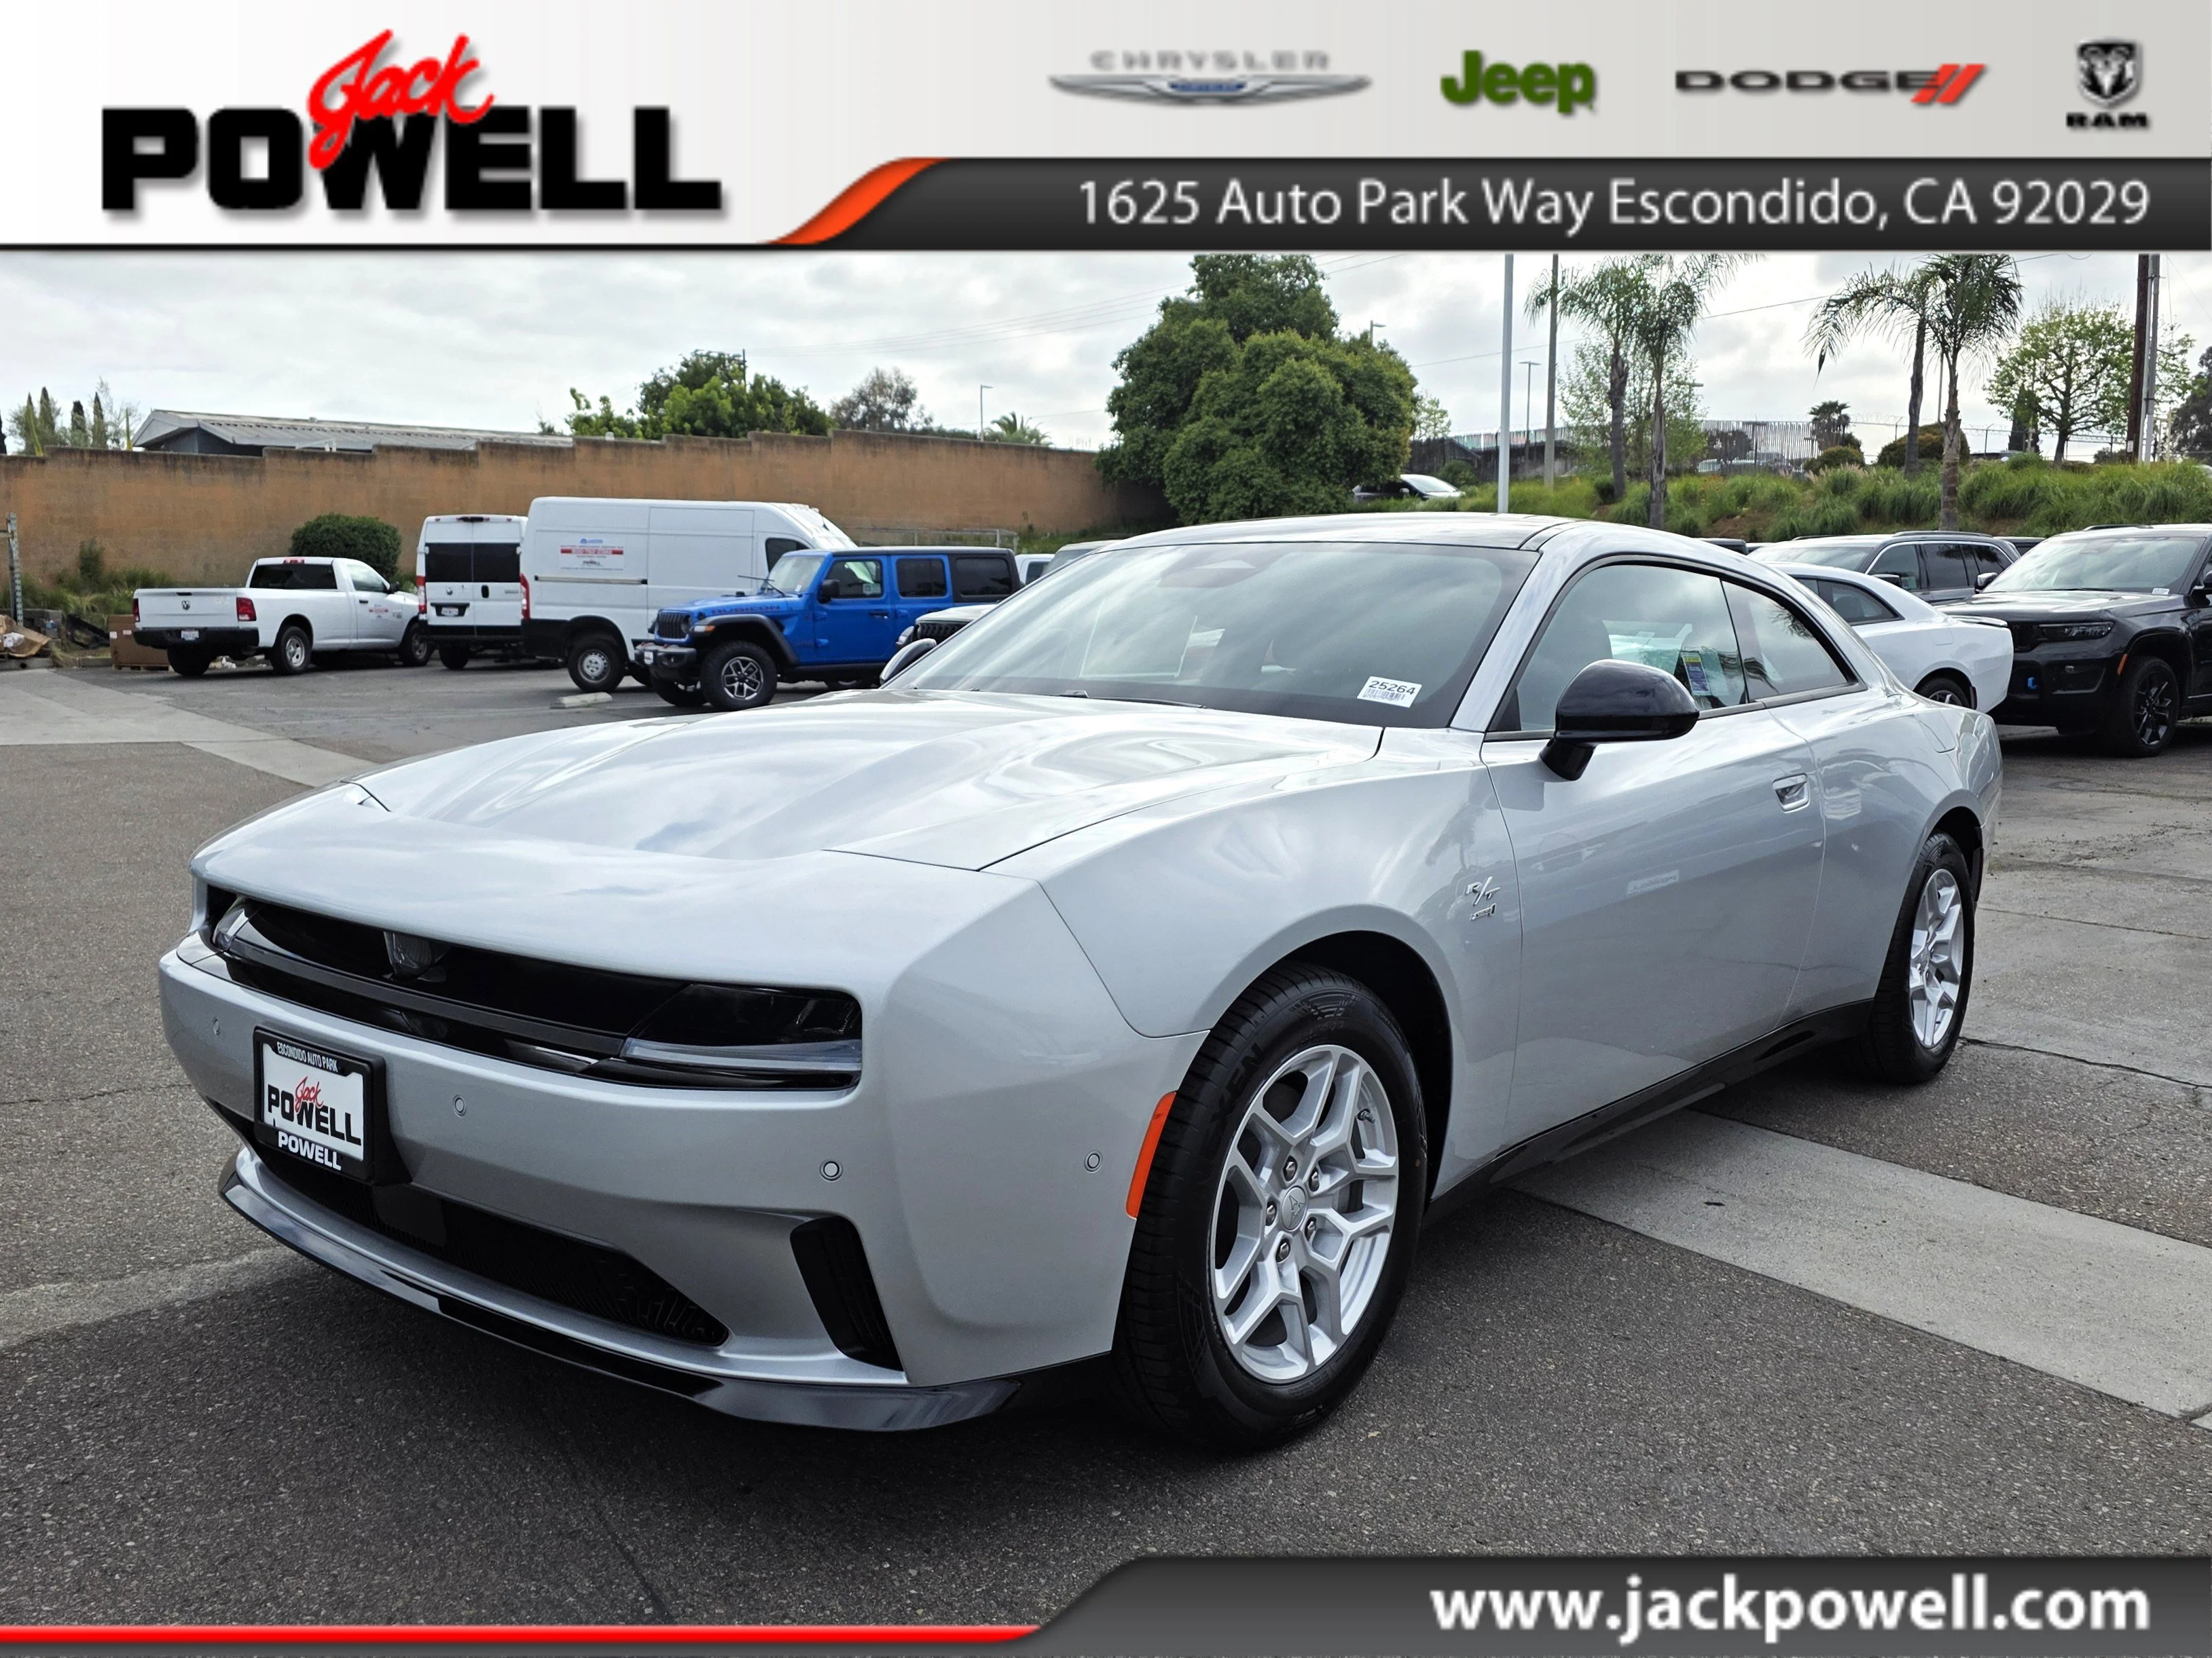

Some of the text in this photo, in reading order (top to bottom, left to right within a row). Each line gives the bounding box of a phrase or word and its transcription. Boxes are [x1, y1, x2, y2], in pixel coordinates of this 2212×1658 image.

[1368, 680, 1416, 695] 25264
[1465, 876, 1500, 906] R/T
[276, 1041, 338, 1073] ESCONDIDO AUTO PARK
[295, 1075, 324, 1114] Jack
[268, 1084, 362, 1146] POWELL
[278, 1130, 342, 1171] POWELL
